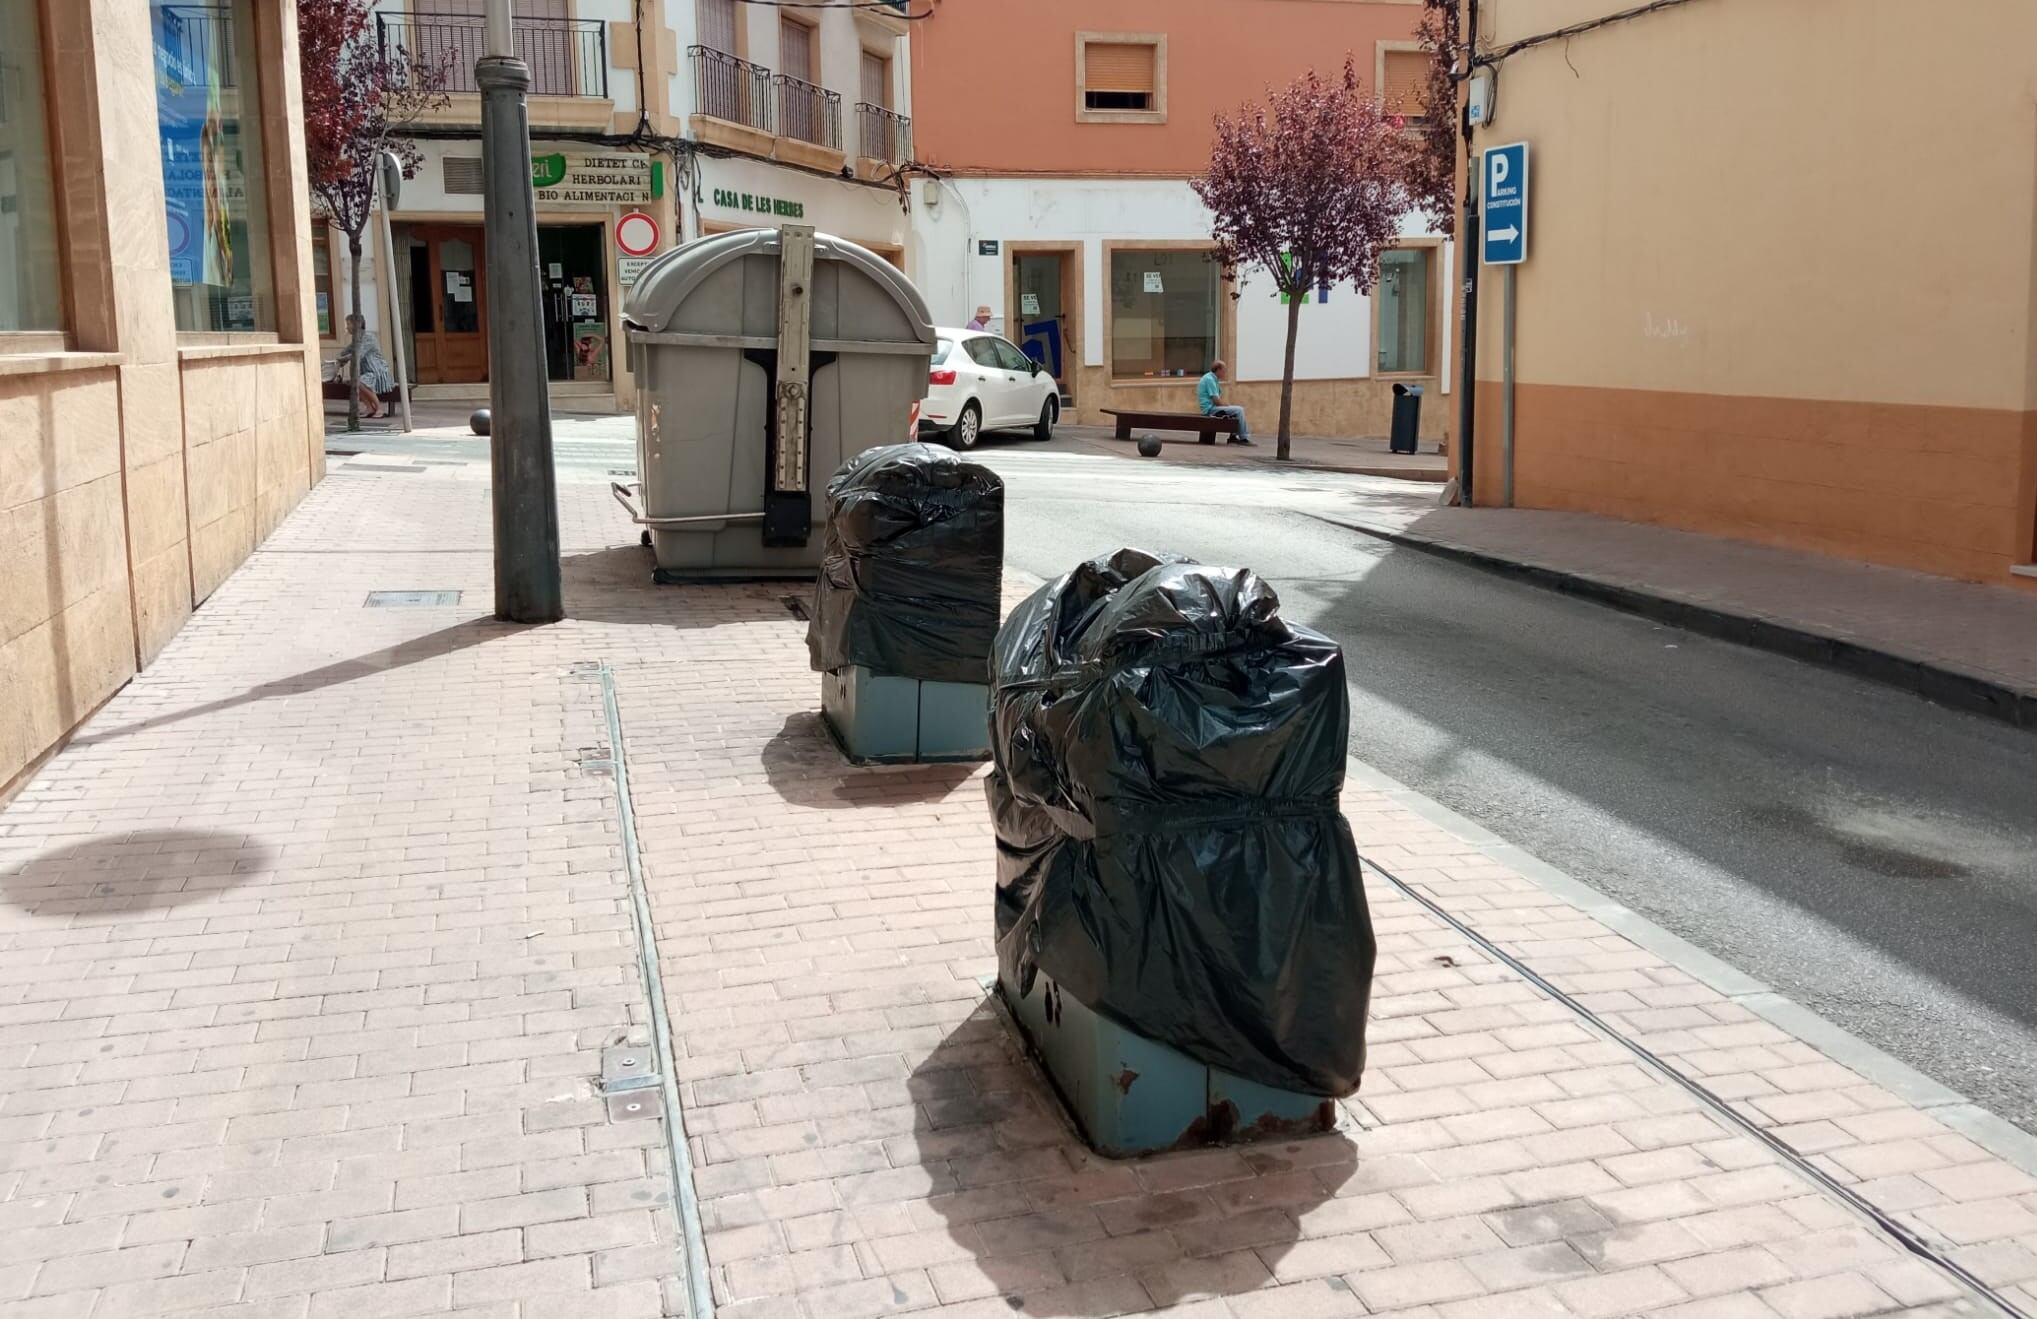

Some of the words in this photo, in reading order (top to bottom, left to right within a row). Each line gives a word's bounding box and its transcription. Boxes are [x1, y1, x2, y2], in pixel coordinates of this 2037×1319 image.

[572, 174, 641, 185] HERBOLARI
[538, 190, 558, 201] BIO
[713, 188, 740, 209] CASA
[741, 193, 754, 211] DE
[755, 195, 772, 214] LES
